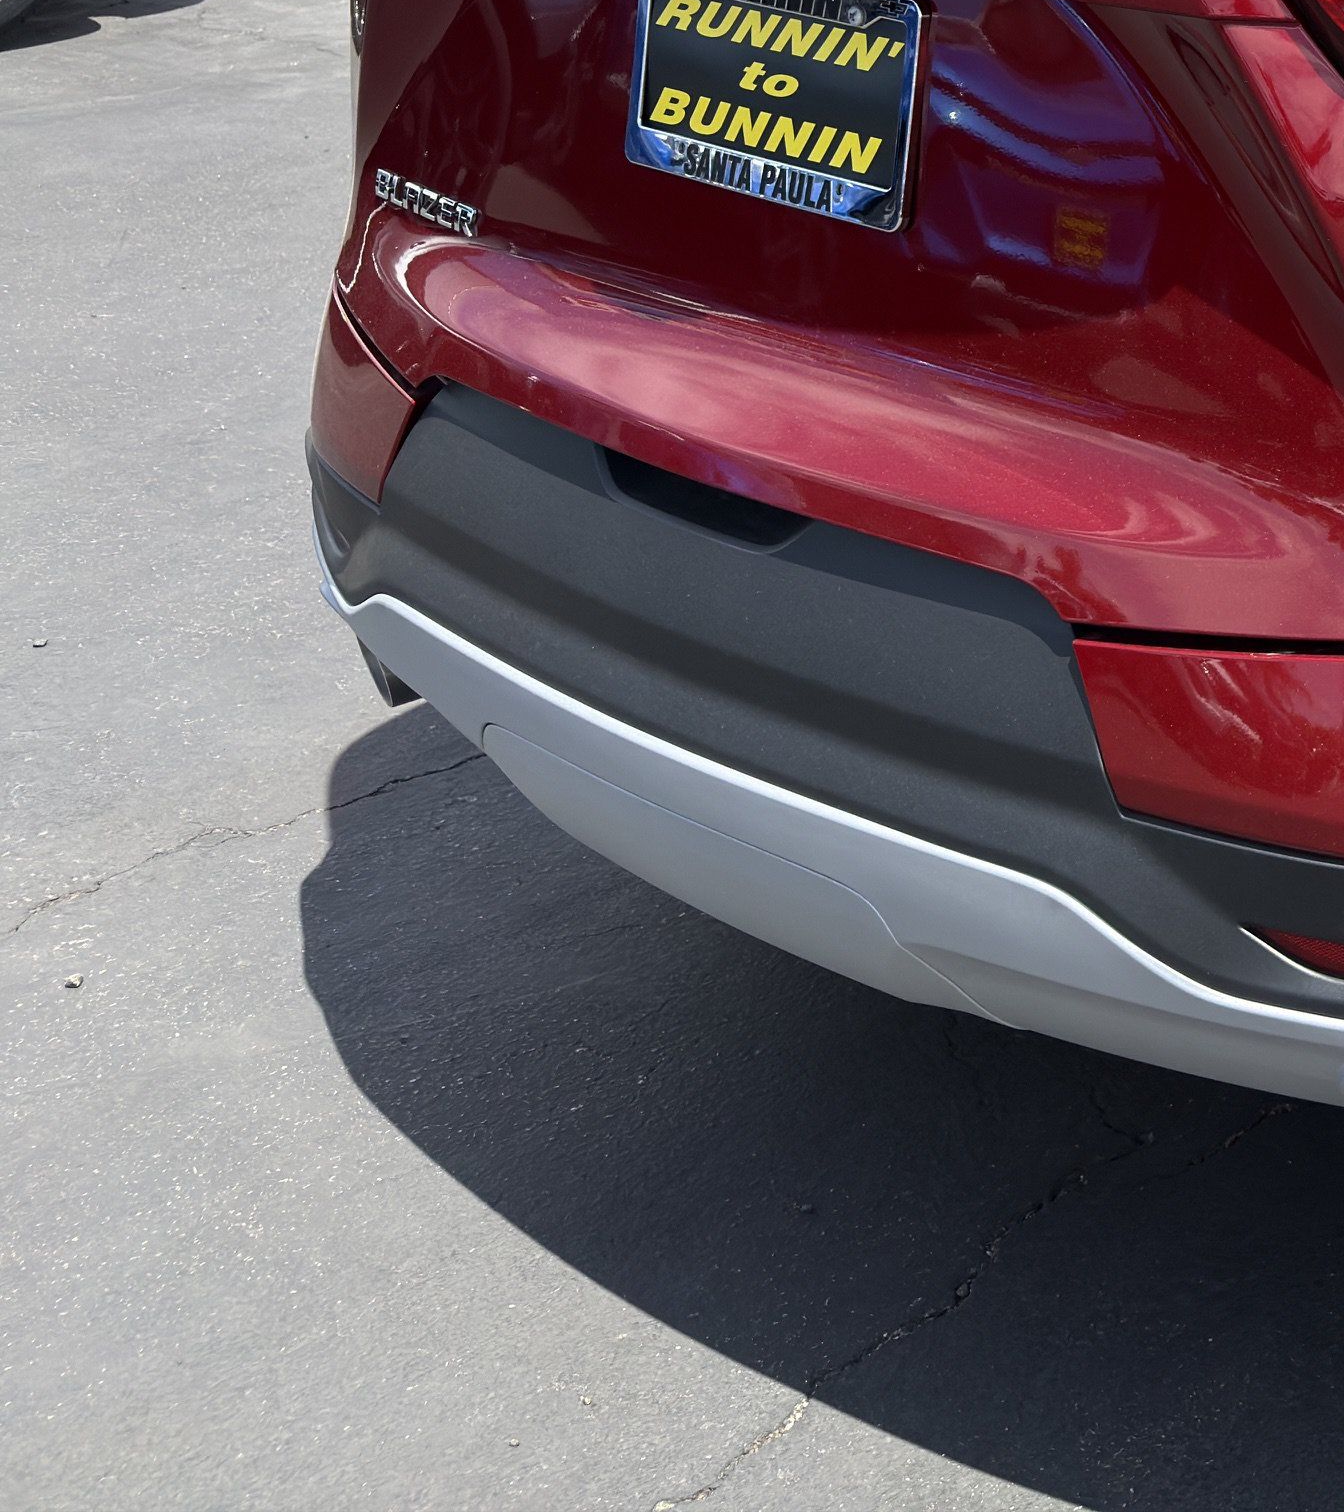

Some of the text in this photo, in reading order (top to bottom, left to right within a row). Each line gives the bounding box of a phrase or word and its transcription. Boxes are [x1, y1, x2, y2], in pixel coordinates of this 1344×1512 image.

[738, 61, 800, 98] to
[649, 87, 883, 175] BUNNIN
[376, 168, 476, 238] BLAZER
[683, 143, 833, 213] SANTA PAULA
